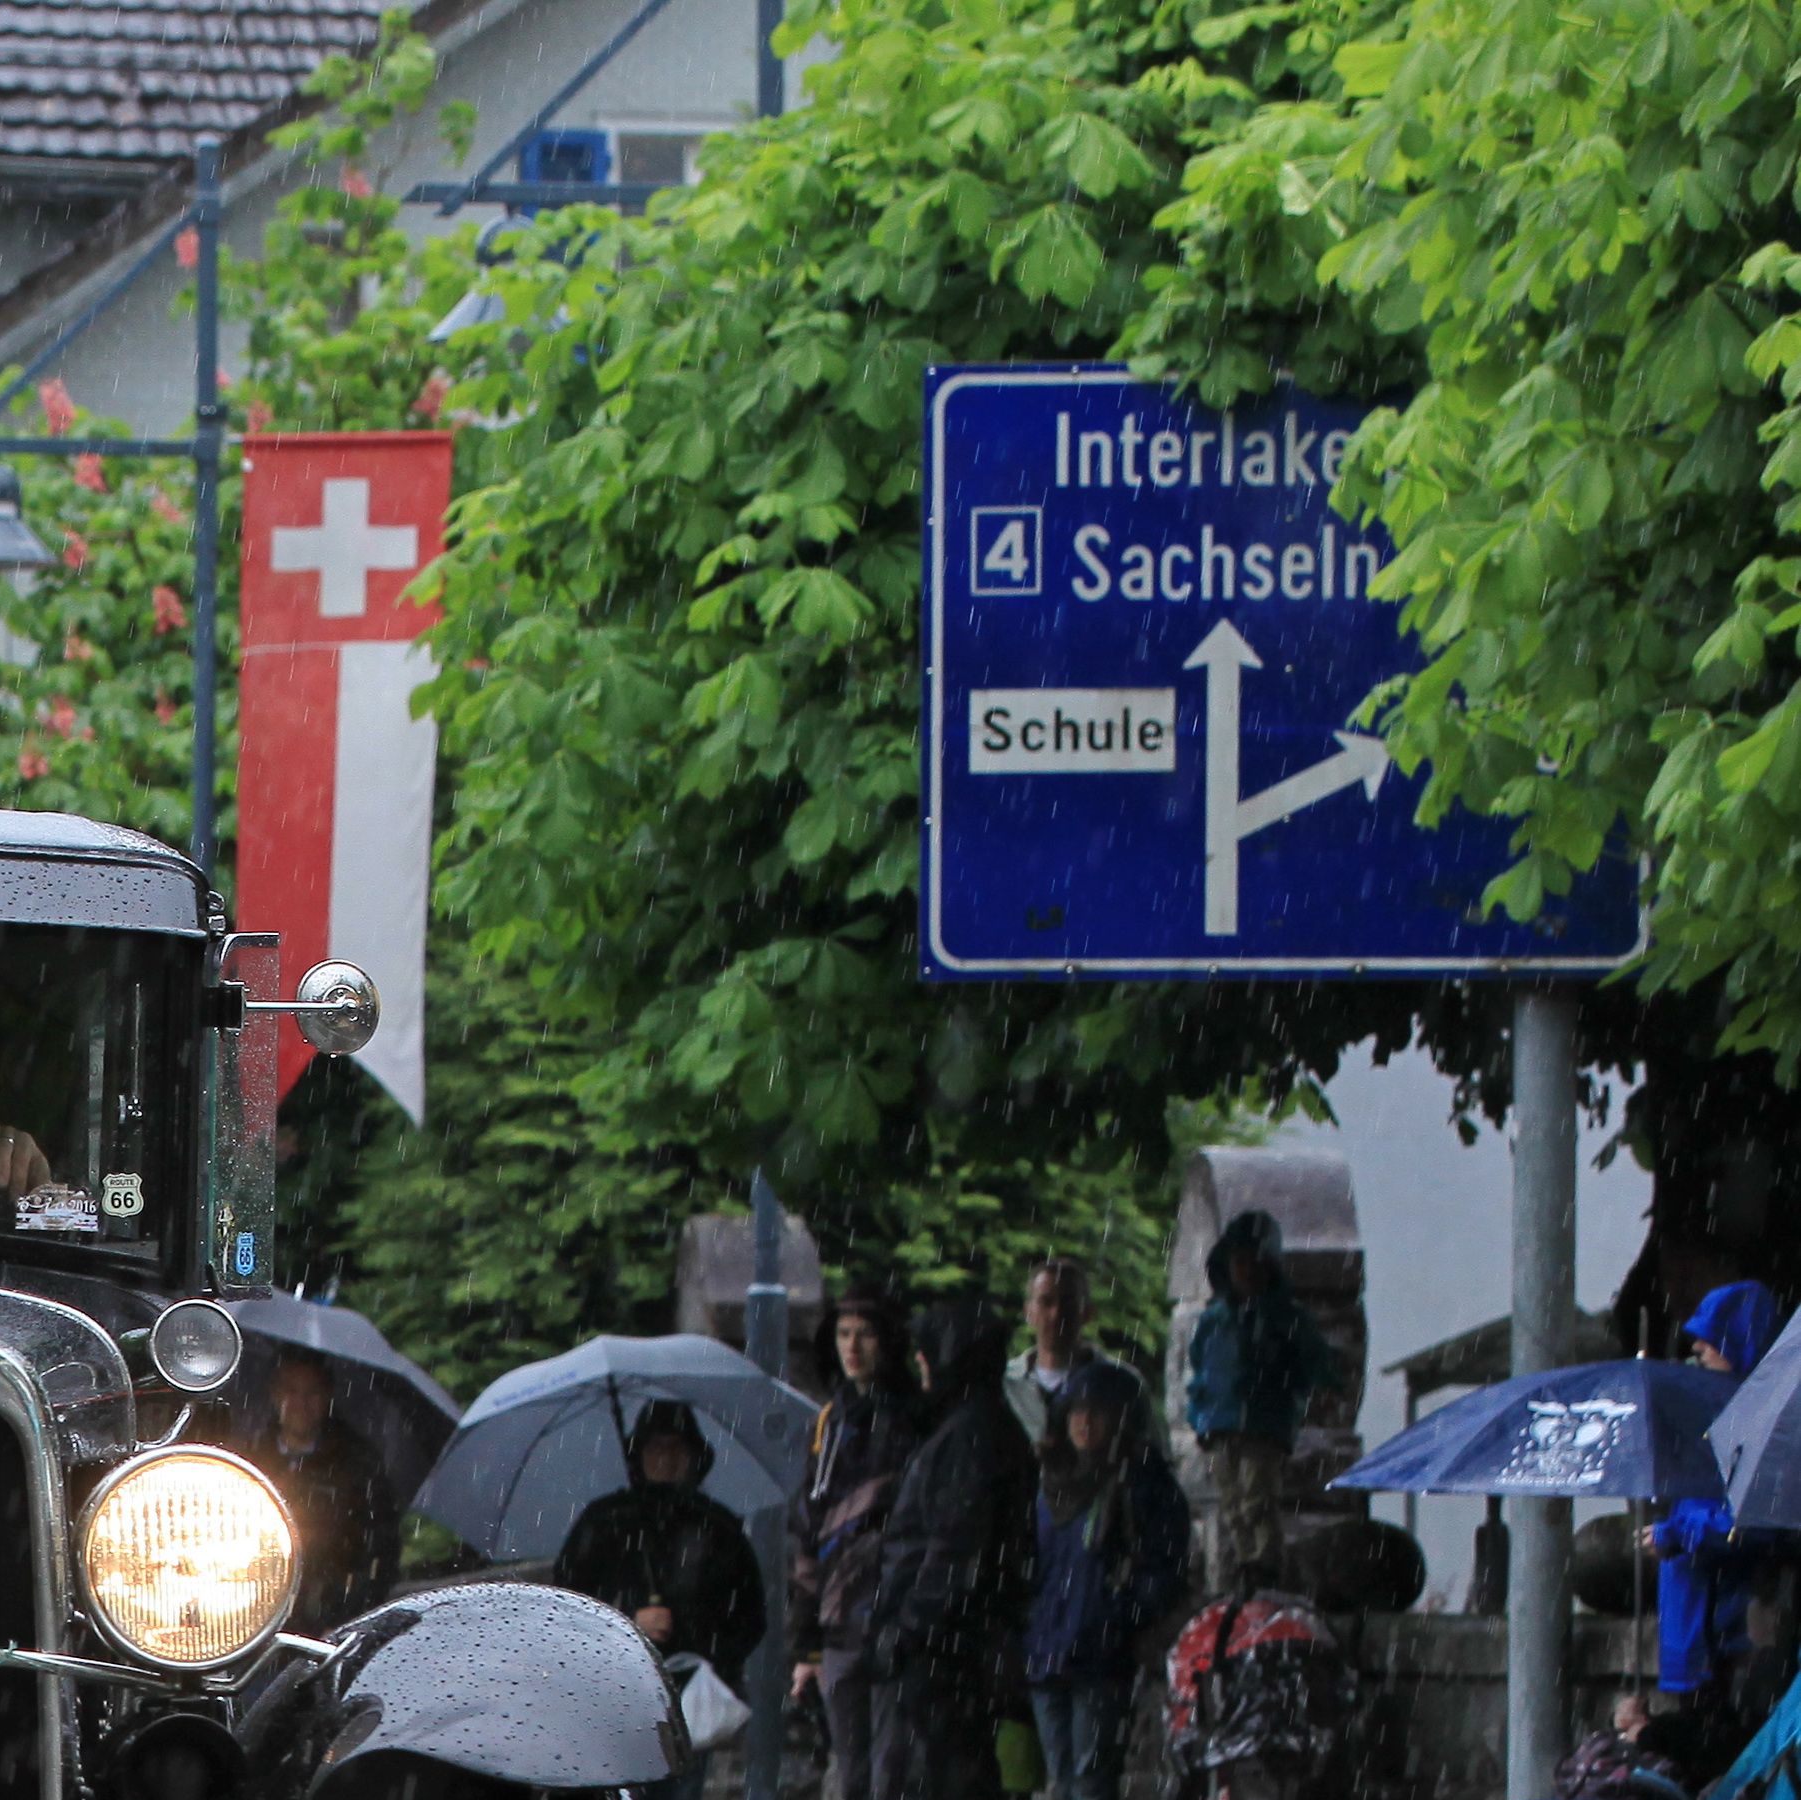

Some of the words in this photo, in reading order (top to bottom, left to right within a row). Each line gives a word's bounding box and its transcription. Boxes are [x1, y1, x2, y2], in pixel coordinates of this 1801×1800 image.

[983, 520, 1029, 582] 4
[1071, 523, 1379, 601] Sachseln
[981, 707, 1164, 753] Schule
[68, 1199, 97, 1214] 2016
[110, 1191, 135, 1209] 66
